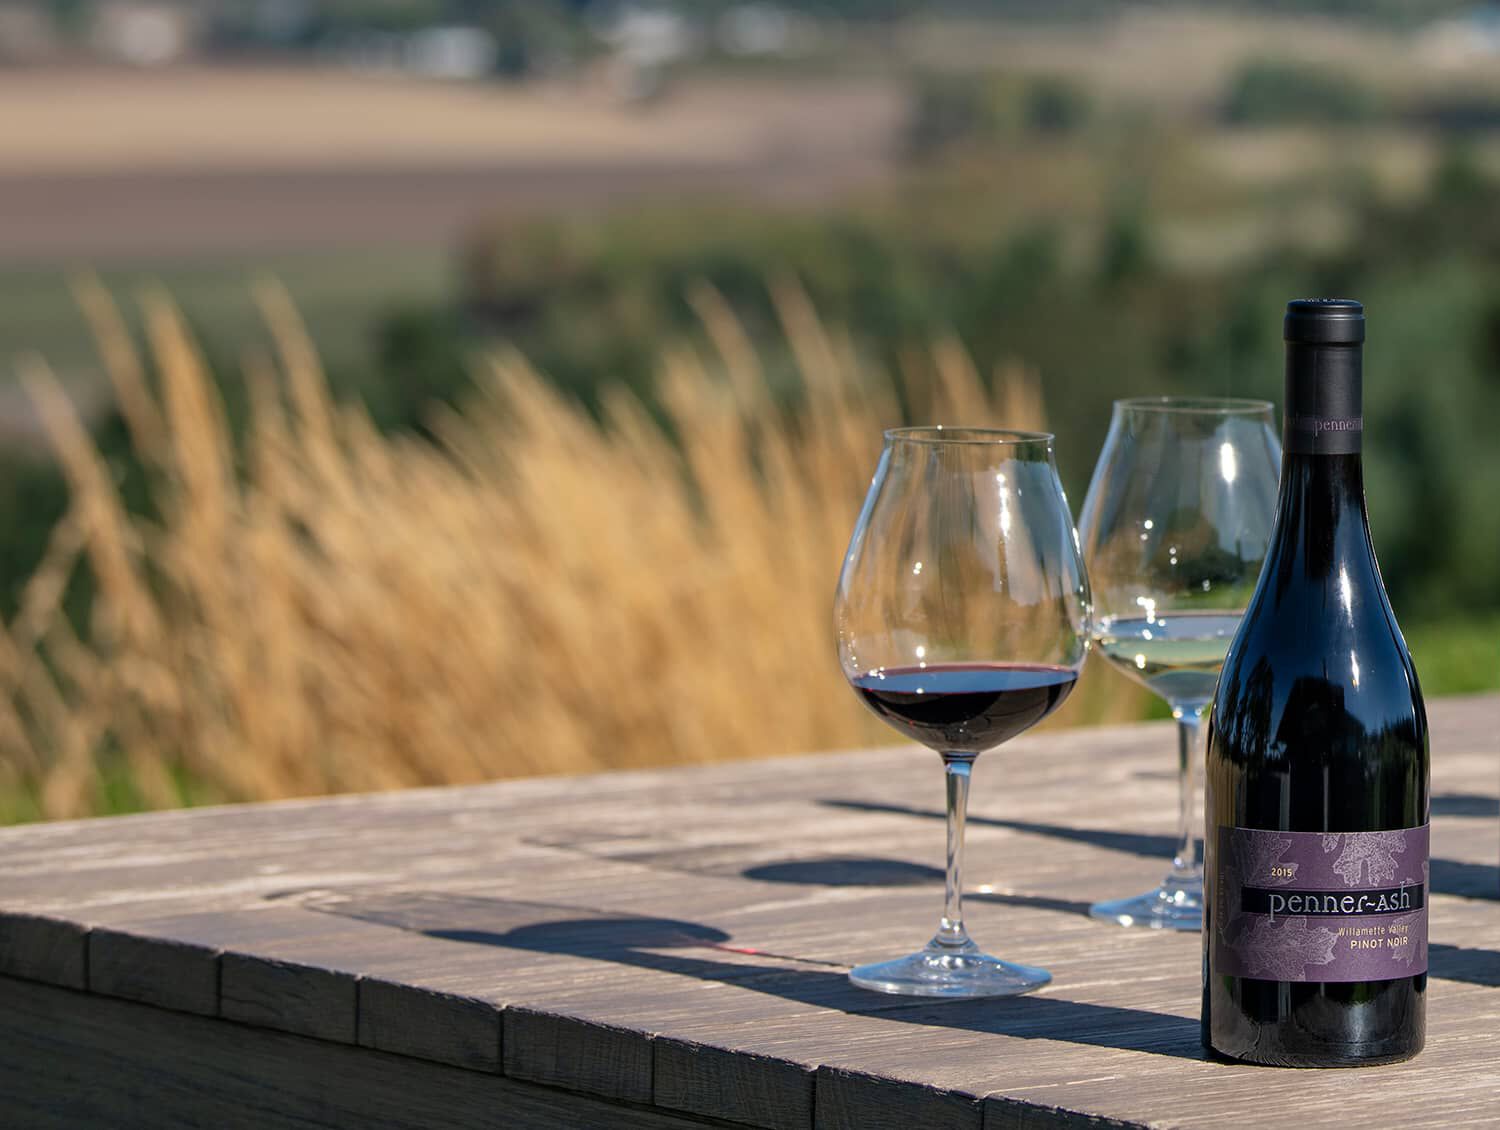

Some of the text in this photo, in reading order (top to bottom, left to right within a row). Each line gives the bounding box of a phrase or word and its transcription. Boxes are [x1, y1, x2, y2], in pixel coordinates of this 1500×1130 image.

[1271, 867, 1293, 877] 2015
[1350, 936, 1408, 949] PINOT NOIR
